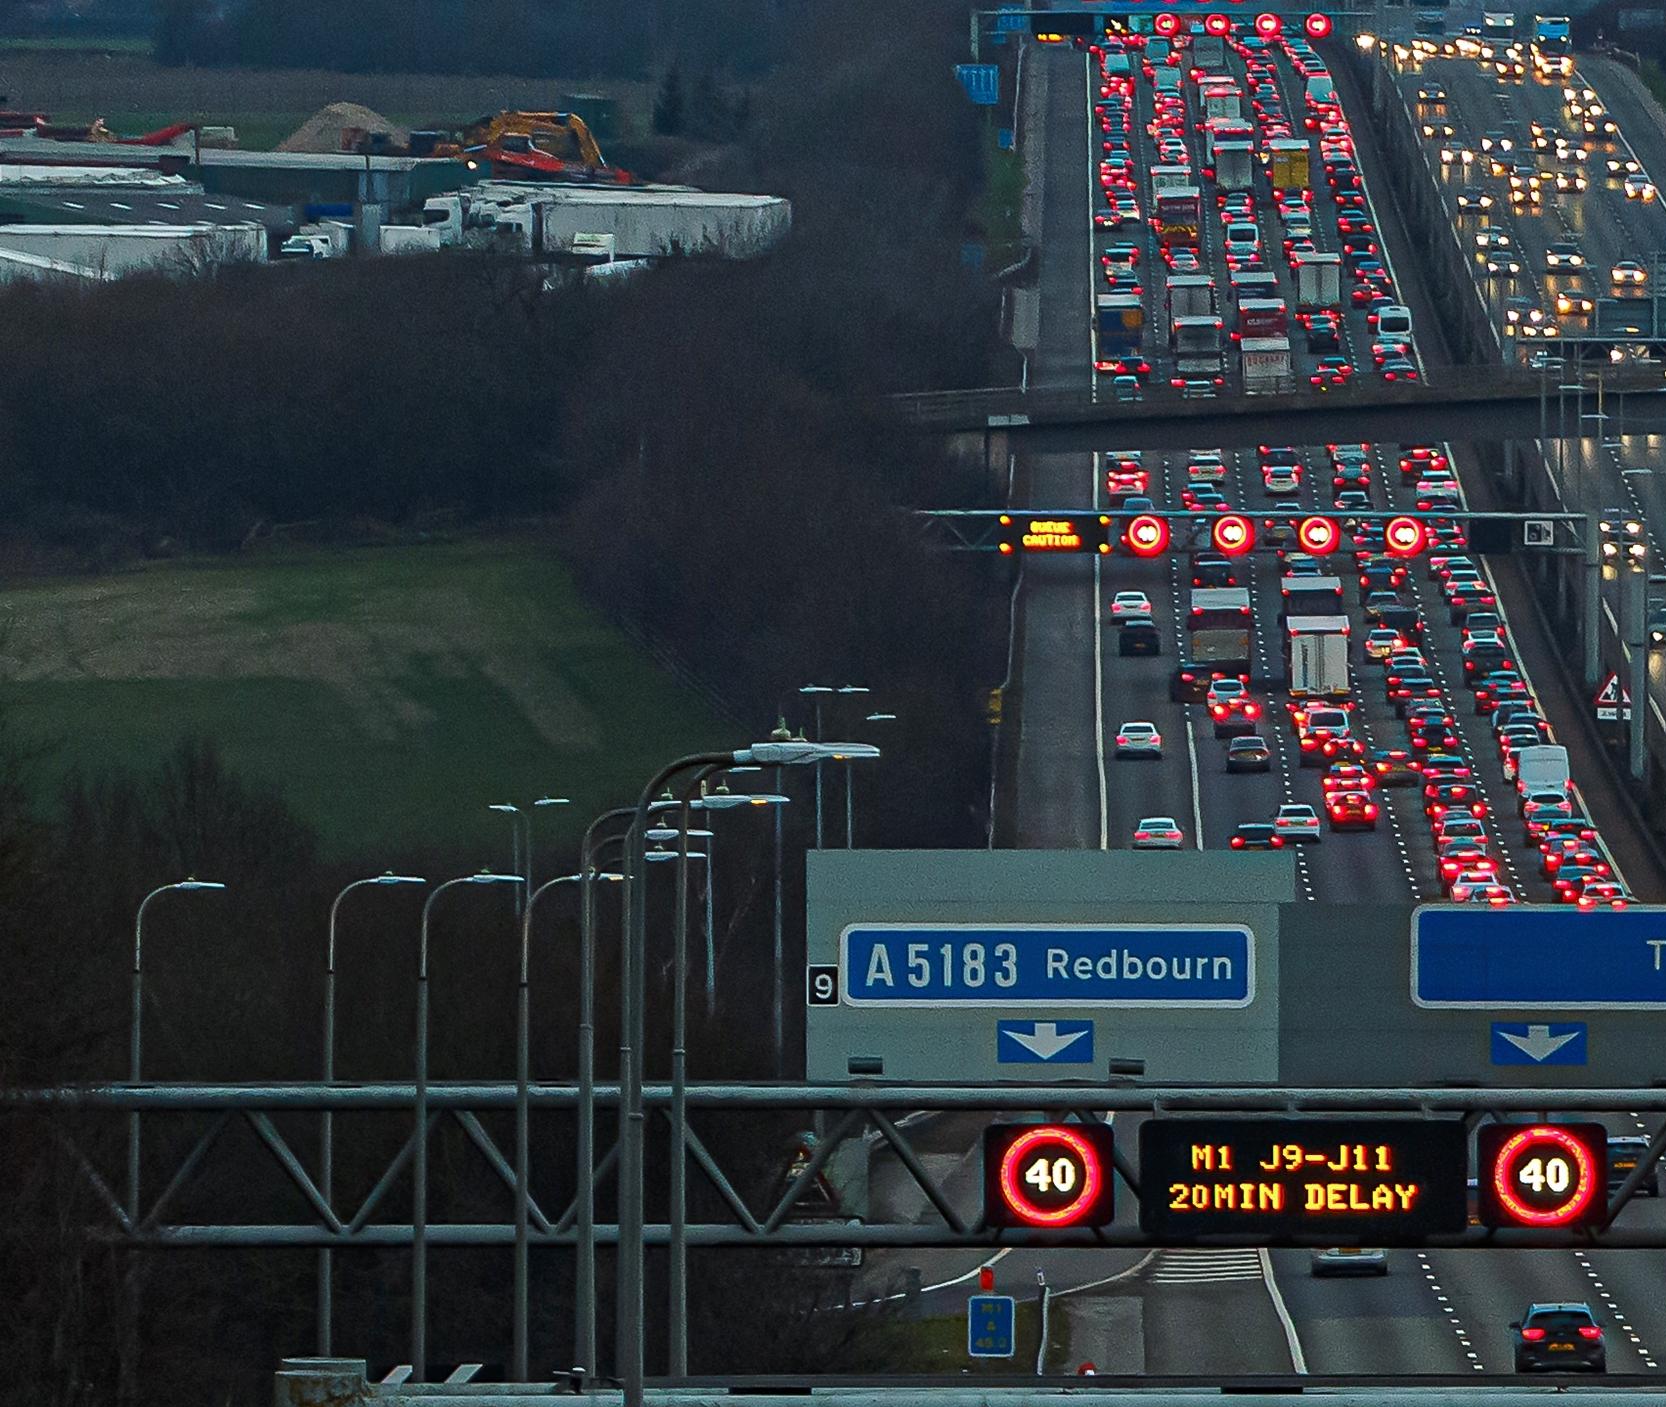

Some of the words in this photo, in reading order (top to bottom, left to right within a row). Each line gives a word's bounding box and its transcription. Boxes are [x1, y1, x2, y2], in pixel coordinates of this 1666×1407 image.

[1047, 949, 1232, 980] Redbourn
[815, 974, 833, 999] 9
[1192, 1144, 1233, 1170] M1
[1259, 1144, 1392, 1171] J9-J11
[1026, 1158, 1076, 1192] 40
[1520, 1158, 1570, 1193] 40
[1305, 1183, 1419, 1211] DELAY
